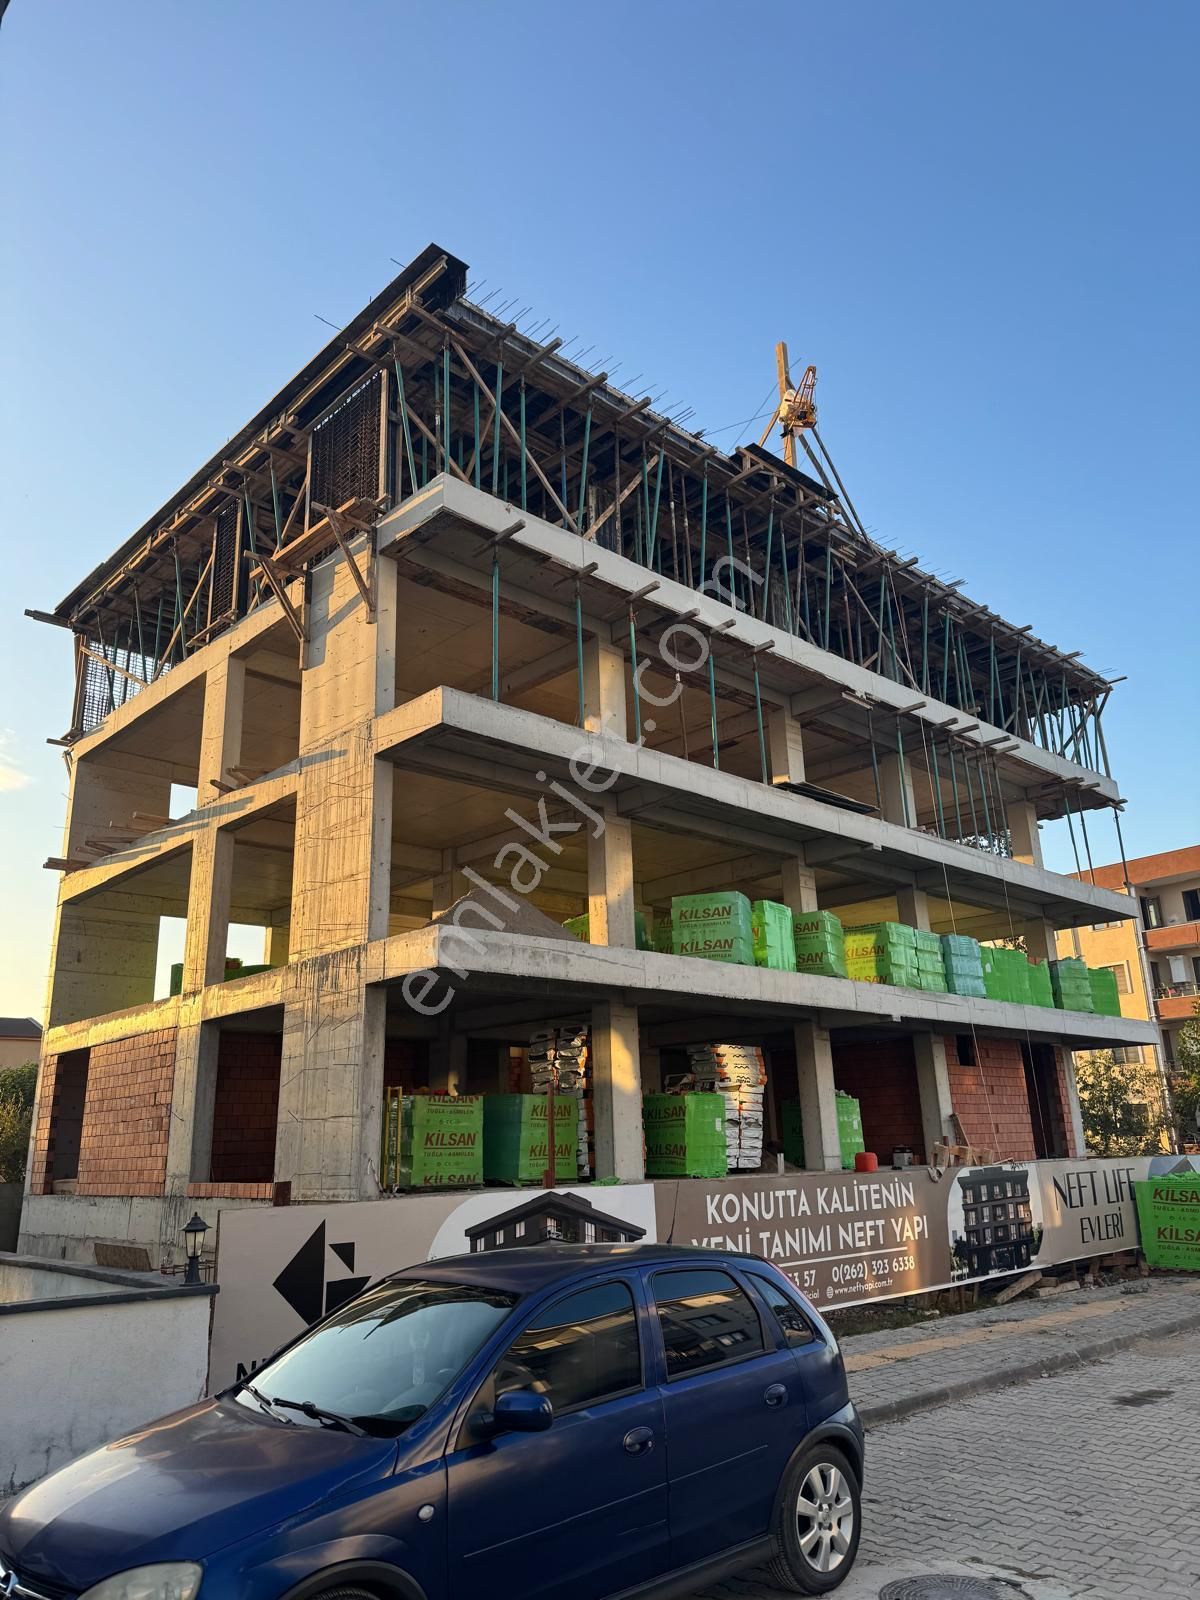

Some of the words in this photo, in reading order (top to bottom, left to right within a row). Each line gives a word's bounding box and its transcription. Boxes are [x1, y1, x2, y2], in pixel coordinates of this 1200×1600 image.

[680, 905, 732, 920] KİLSAN
[680, 938, 734, 953] KİLSAN
[424, 1129, 476, 1146] KİLSAN
[706, 1188, 811, 1225] KONUTTA
[817, 1177, 916, 1214] KALİTENİN
[1052, 1171, 1097, 1211] NEFT
[759, 1225, 832, 1259] TANIMI
[838, 1219, 885, 1249] NEFT
[890, 1215, 929, 1241] YAPI
[1080, 1206, 1124, 1244] EVLERİ
[804, 1270, 816, 1287] 57
[832, 1261, 868, 1284] 0(262)
[872, 1259, 889, 1276] 323
[892, 1256, 915, 1272] 6338
[835, 1278, 893, 1295] www.neftyapi.com.tr
